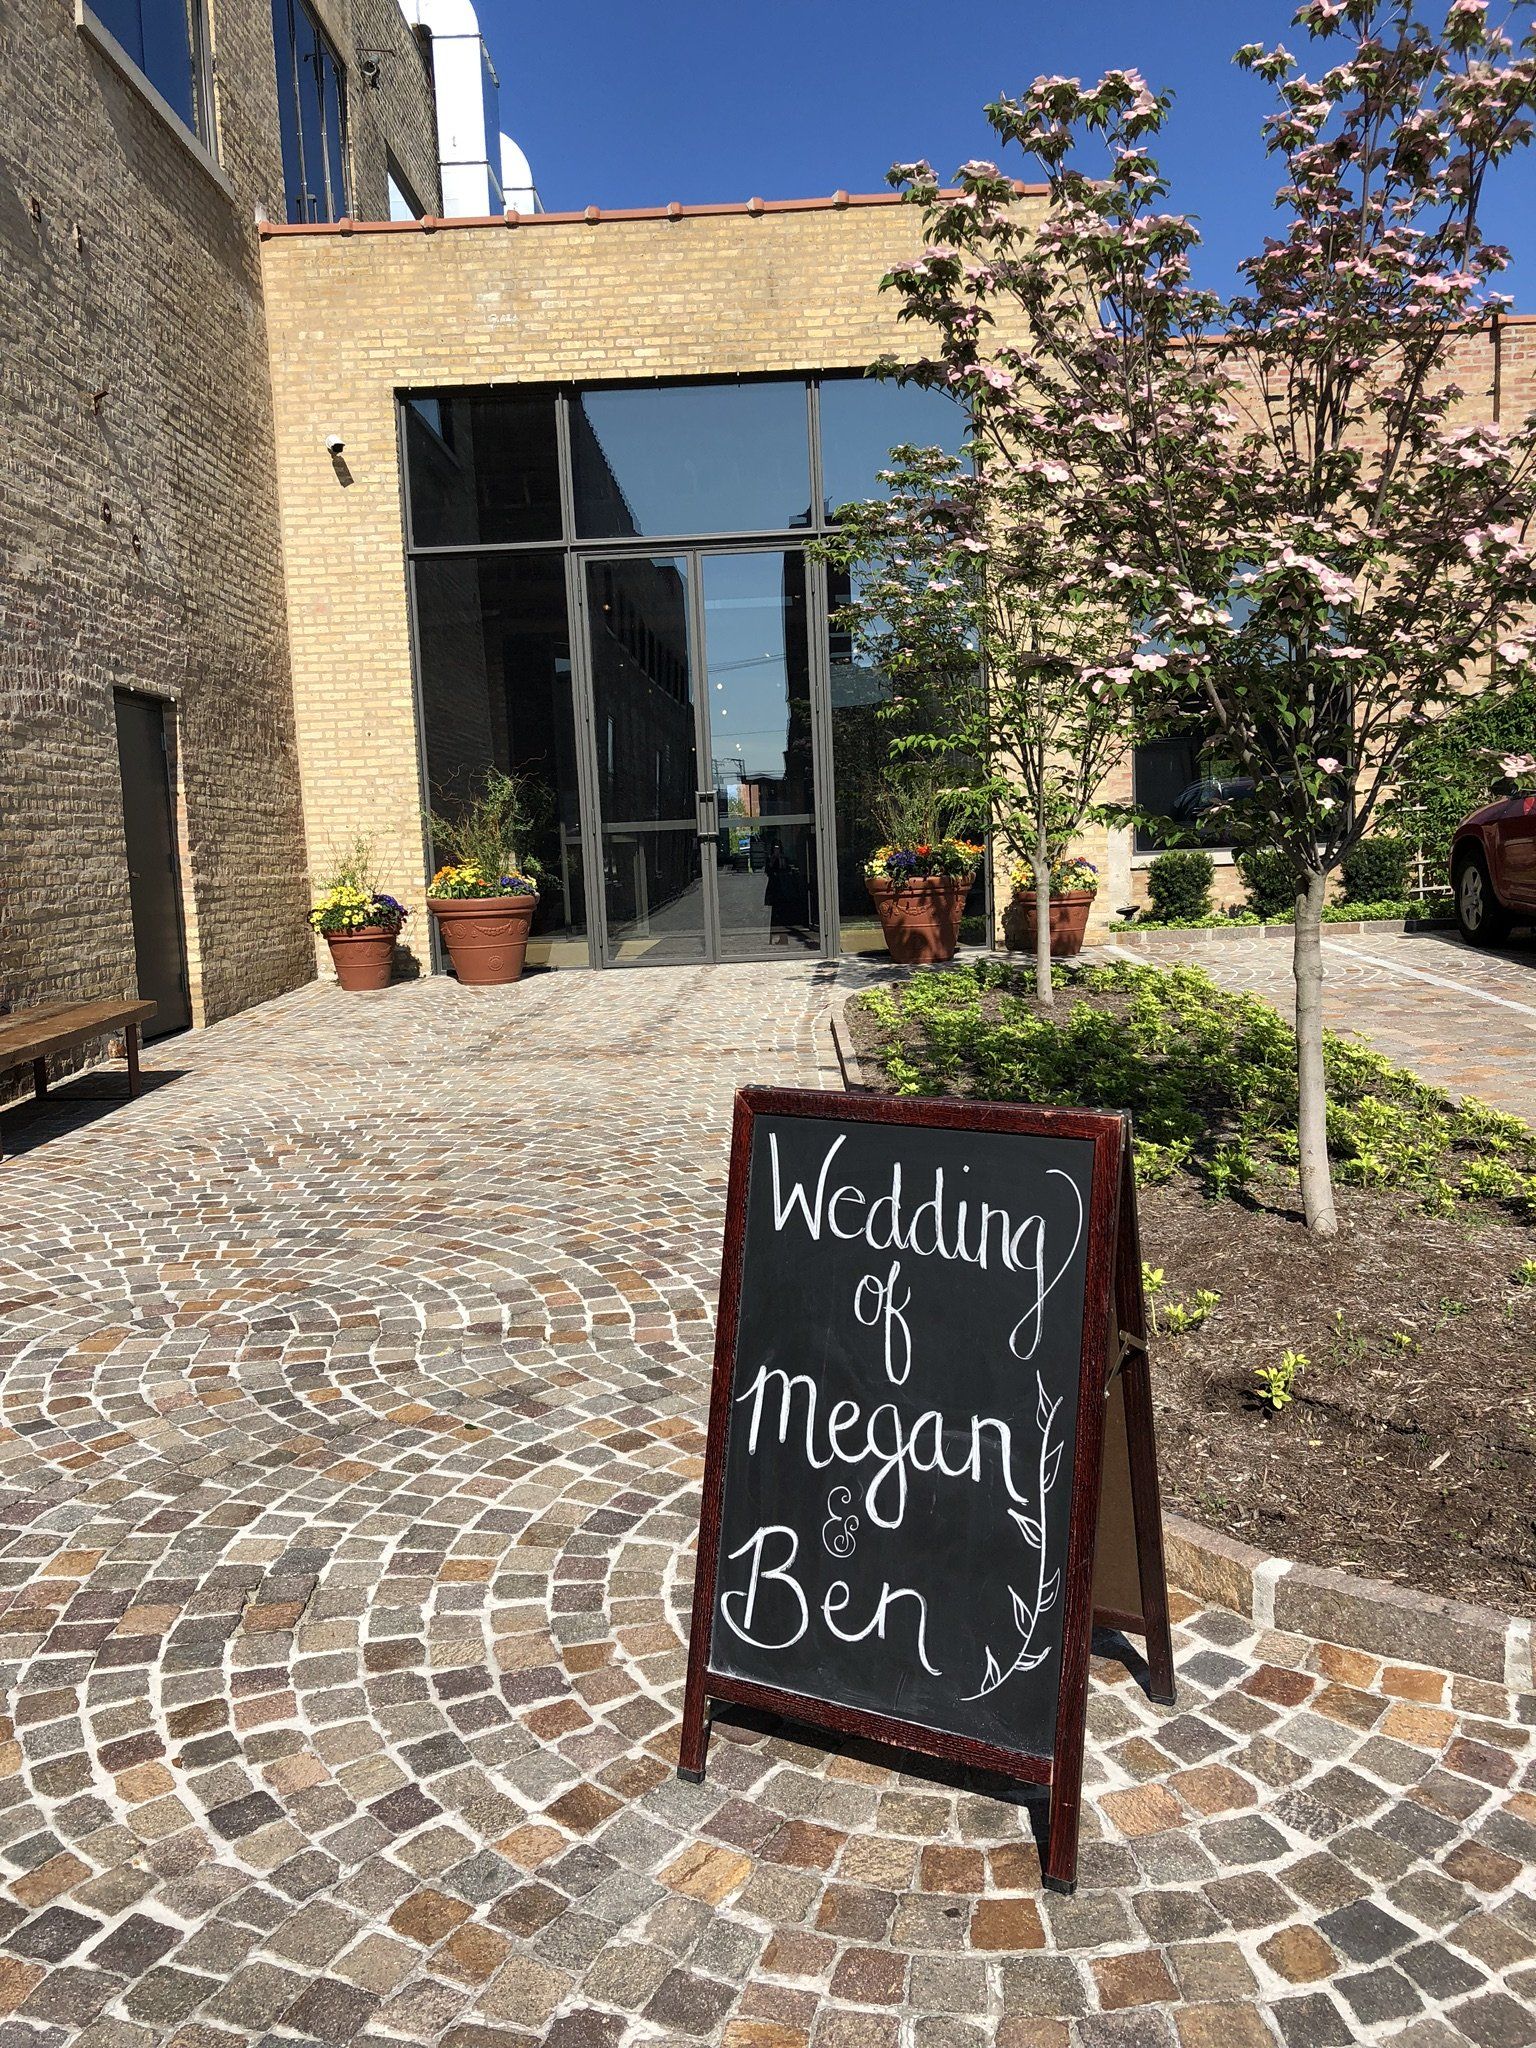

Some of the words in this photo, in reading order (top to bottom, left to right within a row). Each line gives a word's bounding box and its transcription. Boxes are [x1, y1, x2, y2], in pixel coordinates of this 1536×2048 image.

[769, 1132, 1082, 1359] Wedding
[853, 1261, 911, 1385] of
[735, 1365, 1029, 1528] Megan
[821, 1485, 859, 1558] &
[720, 1525, 942, 1676] Ben
